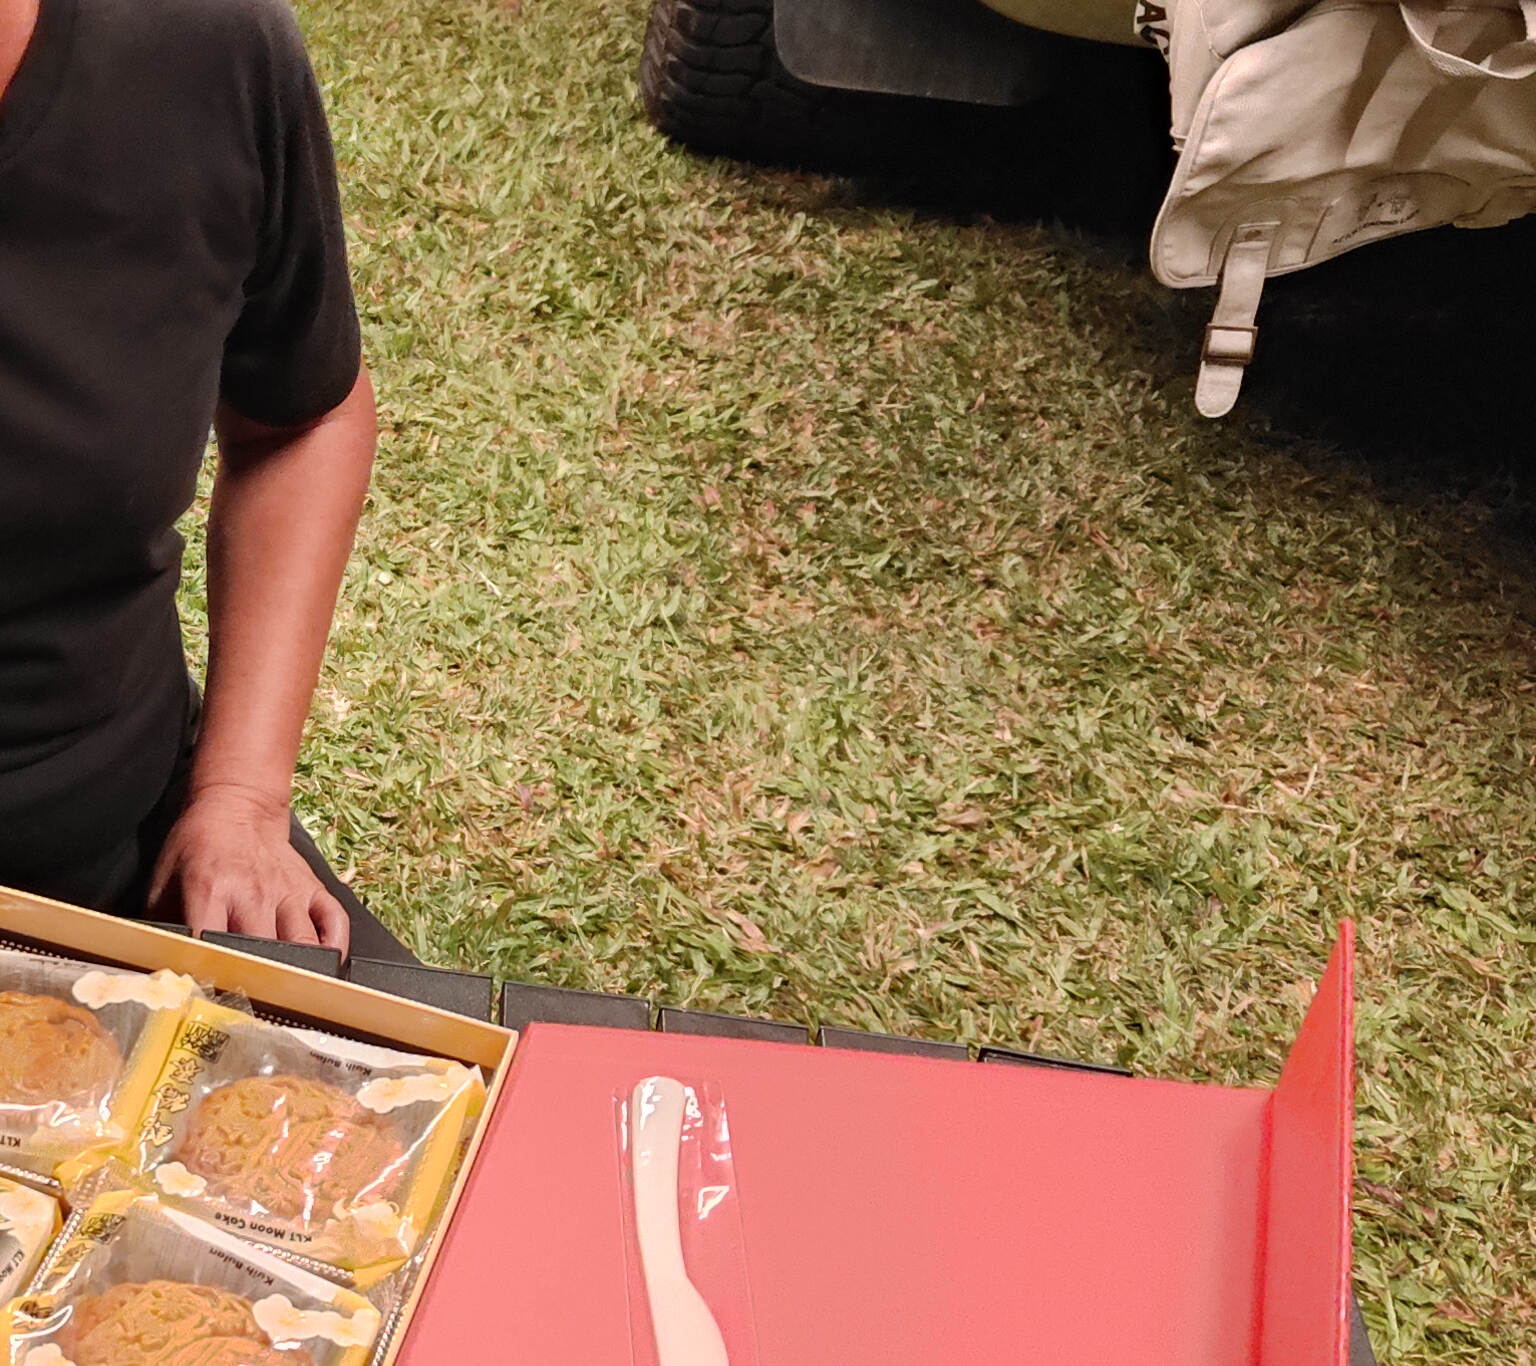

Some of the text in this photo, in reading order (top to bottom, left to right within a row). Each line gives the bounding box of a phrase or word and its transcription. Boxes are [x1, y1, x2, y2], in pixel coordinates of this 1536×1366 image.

[345, 1060, 373, 1077] Kuih
[0, 1136, 22, 1147] KLT
[214, 1211, 313, 1244] KLT Moon Cake
